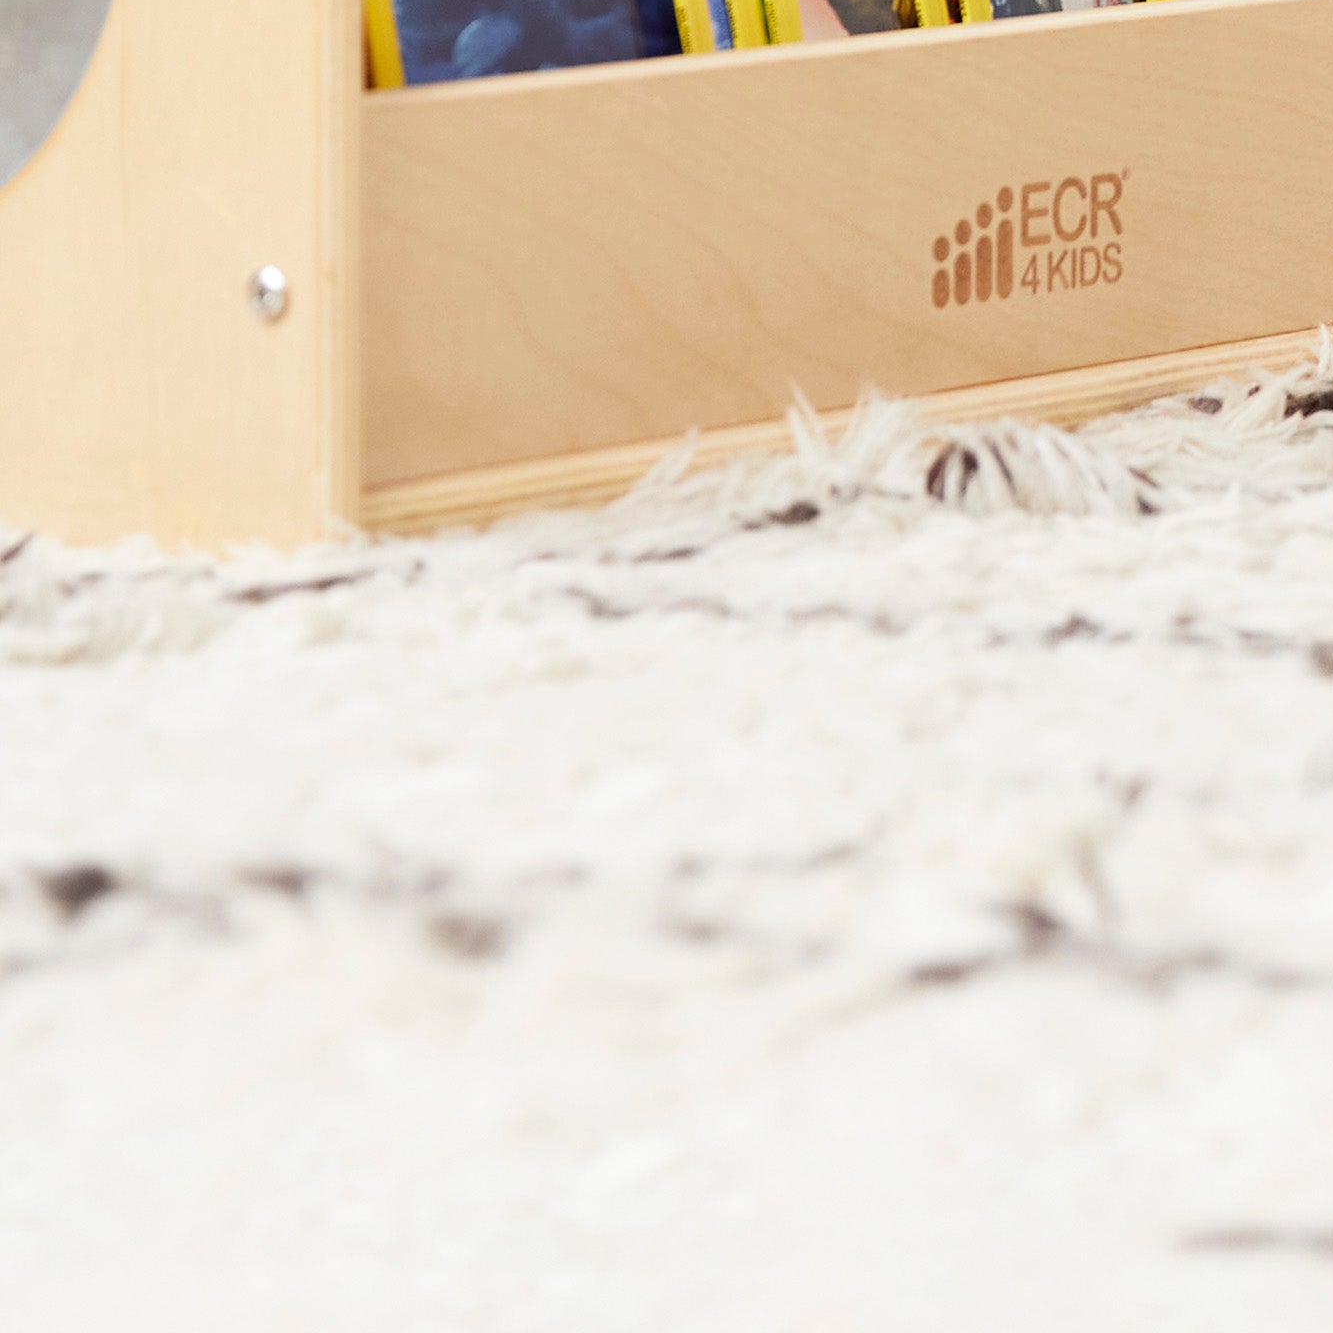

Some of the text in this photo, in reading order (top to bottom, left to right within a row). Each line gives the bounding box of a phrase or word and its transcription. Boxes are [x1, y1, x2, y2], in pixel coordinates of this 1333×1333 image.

[1020, 172, 1124, 247] ECR
[1020, 242, 1124, 294] 4 KIDS
